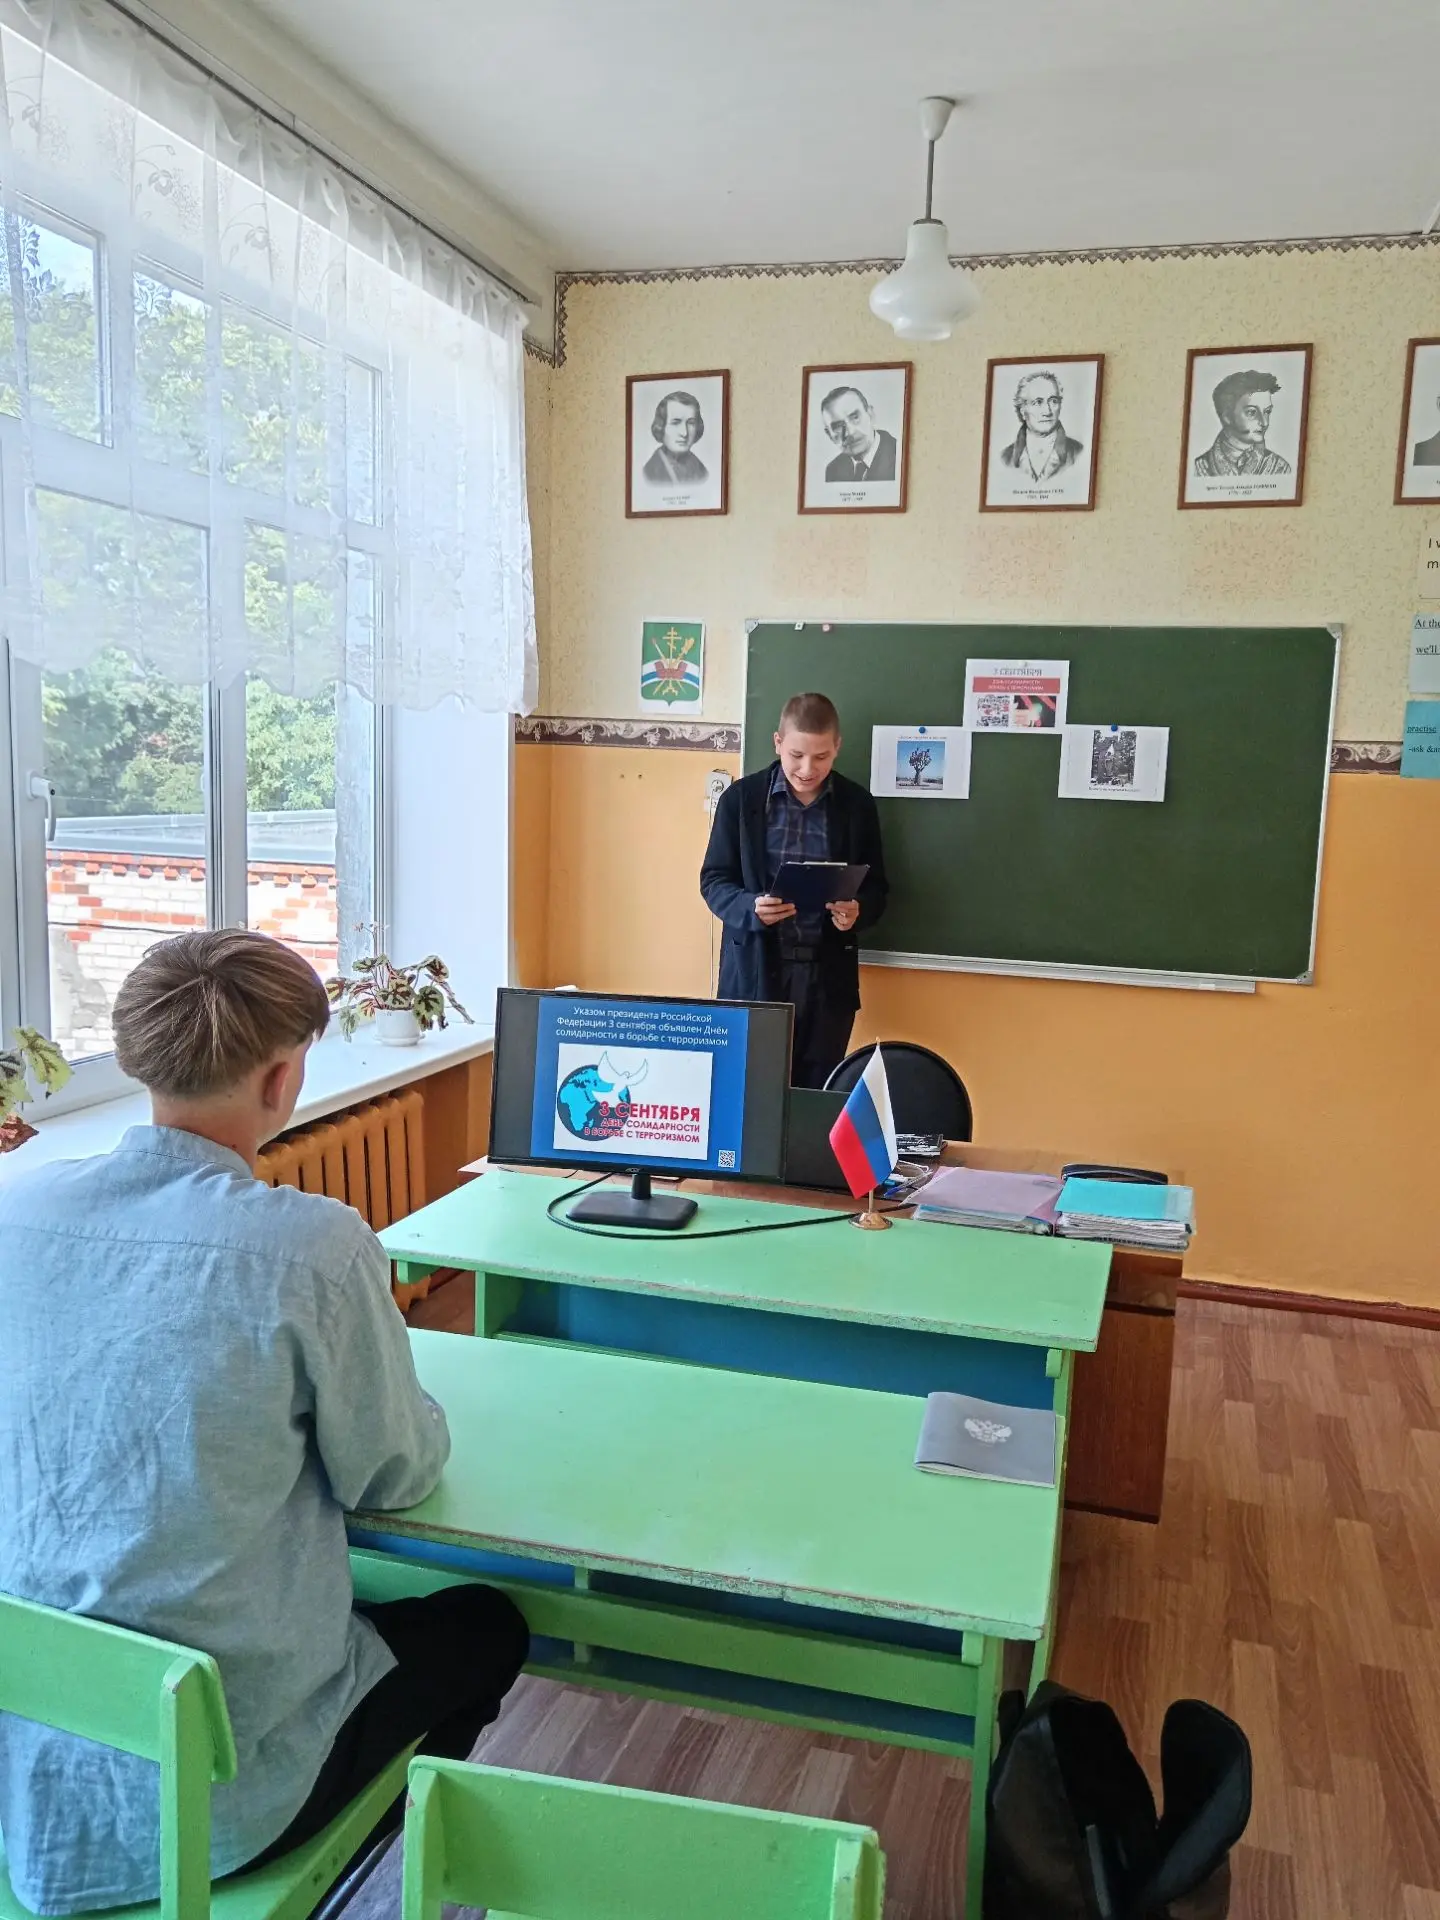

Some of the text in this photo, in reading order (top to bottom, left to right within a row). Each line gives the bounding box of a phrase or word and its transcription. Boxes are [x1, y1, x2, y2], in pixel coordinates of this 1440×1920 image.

[1415, 619, 1426, 628] At
[1416, 644, 1437, 655] we'll
[573, 1006, 712, 1023] Указом президента Российской
[557, 1017, 728, 1036] Федерации 3 сентября объявлен Днём
[556, 1029, 617, 1040] солидарности
[626, 1032, 659, 1043] борьбе
[668, 1036, 728, 1046] терроризмом
[600, 1101, 701, 1122] 3 СЕНТЯБРЯ
[601, 1118, 701, 1133] ДЕНЬ СОЛИДАРНОСТИ
[584, 1127, 590, 1135] В
[591, 1128, 624, 1137] БОРЬБЕ
[635, 1131, 700, 1143] ТЕРРОРИЗМОМ
